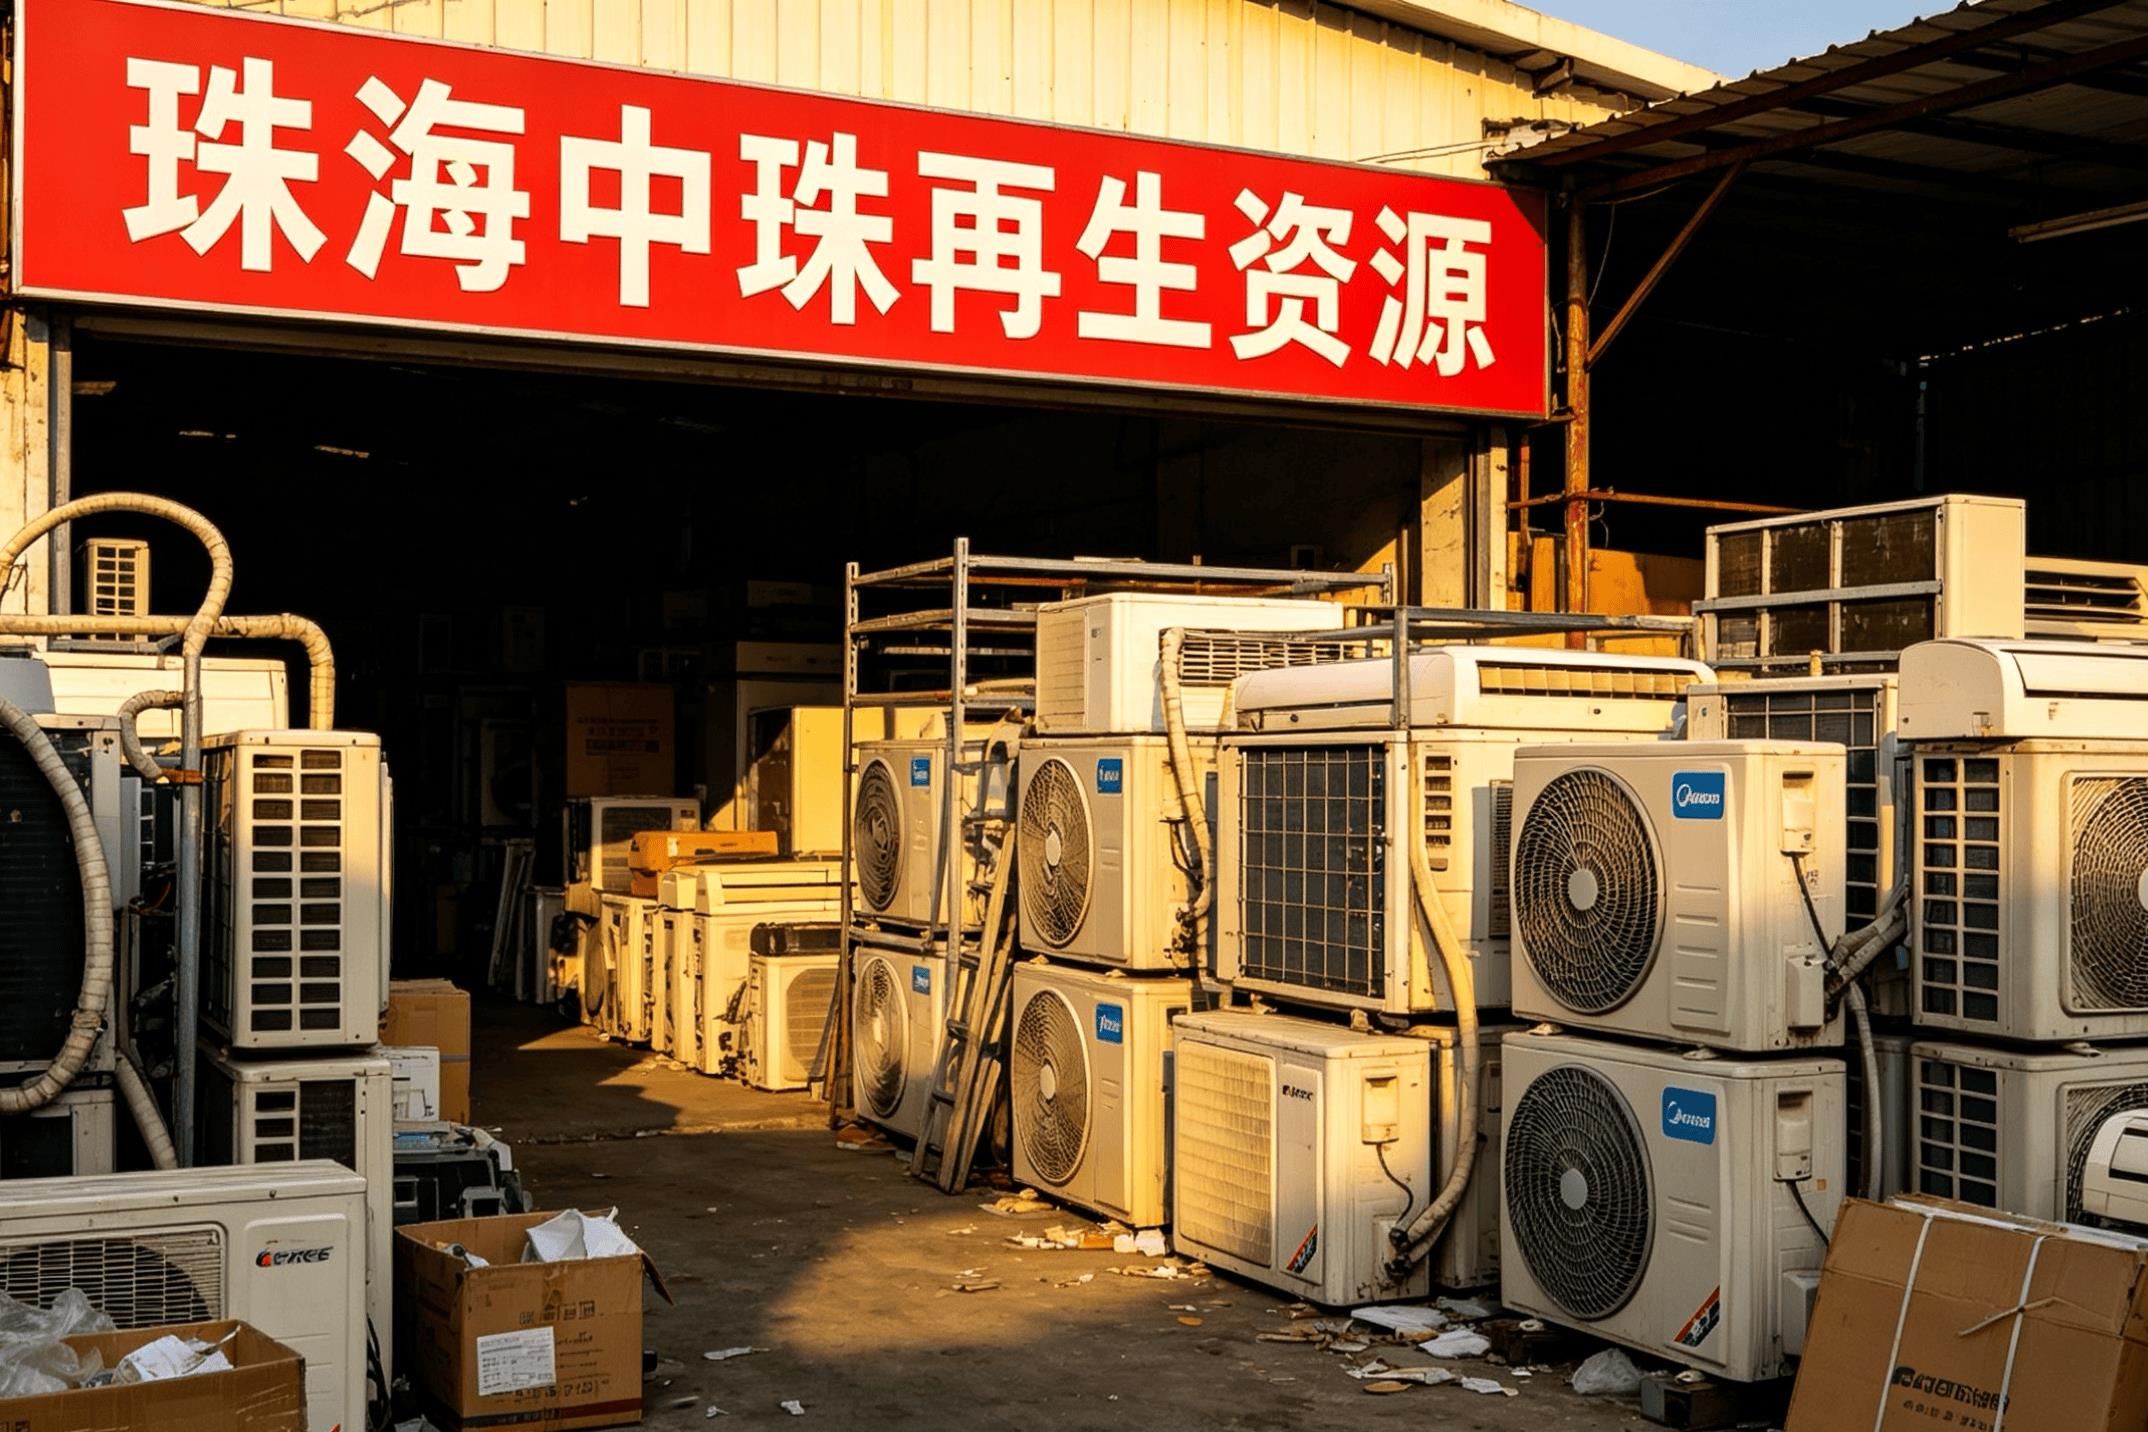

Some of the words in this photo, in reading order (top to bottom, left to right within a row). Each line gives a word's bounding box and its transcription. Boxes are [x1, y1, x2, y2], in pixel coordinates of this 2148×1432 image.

[123, 57, 1494, 376] 珠海中珠再生资源
